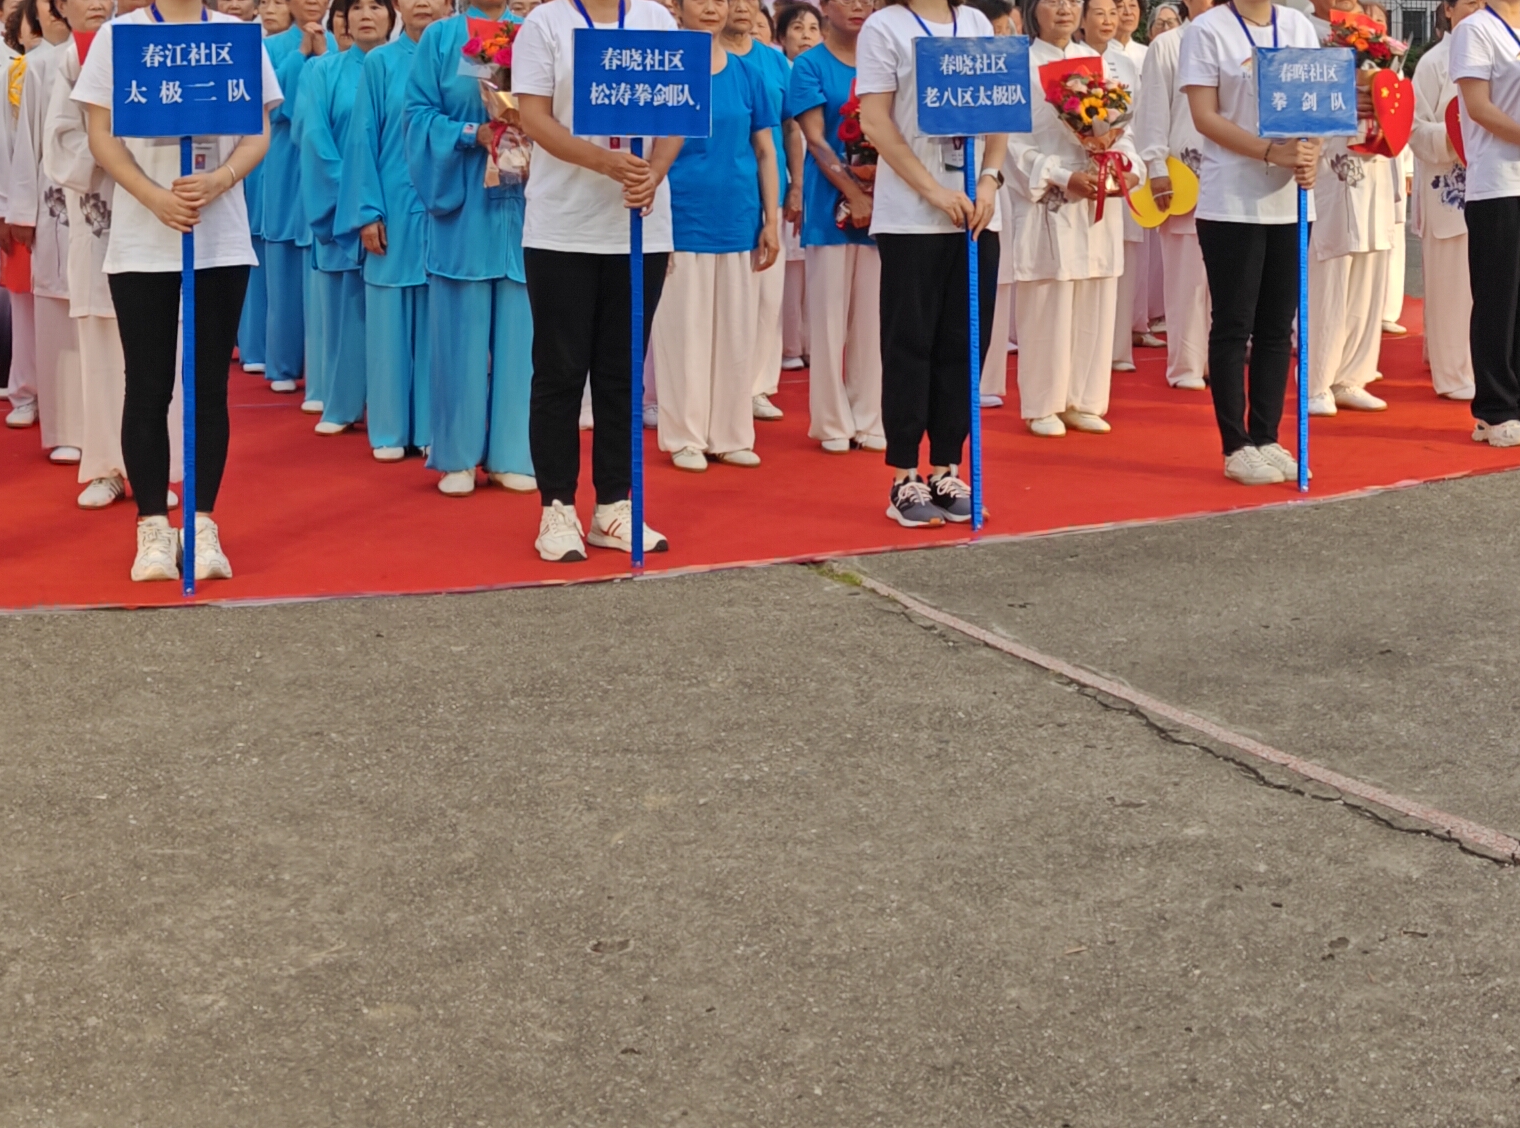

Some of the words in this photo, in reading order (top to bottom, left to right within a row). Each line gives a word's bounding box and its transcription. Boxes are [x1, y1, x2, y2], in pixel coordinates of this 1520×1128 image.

[143, 43, 233, 67] 春江社区
[602, 48, 684, 71] 春晓社区
[939, 53, 1008, 75] 春晓社区
[1278, 62, 1338, 84] 春晖社区
[126, 79, 250, 104] 太极二队
[590, 82, 695, 106] 松涛拳剑队
[923, 84, 1026, 108] 老八区太极队
[1272, 92, 1346, 111] 拳剑队
